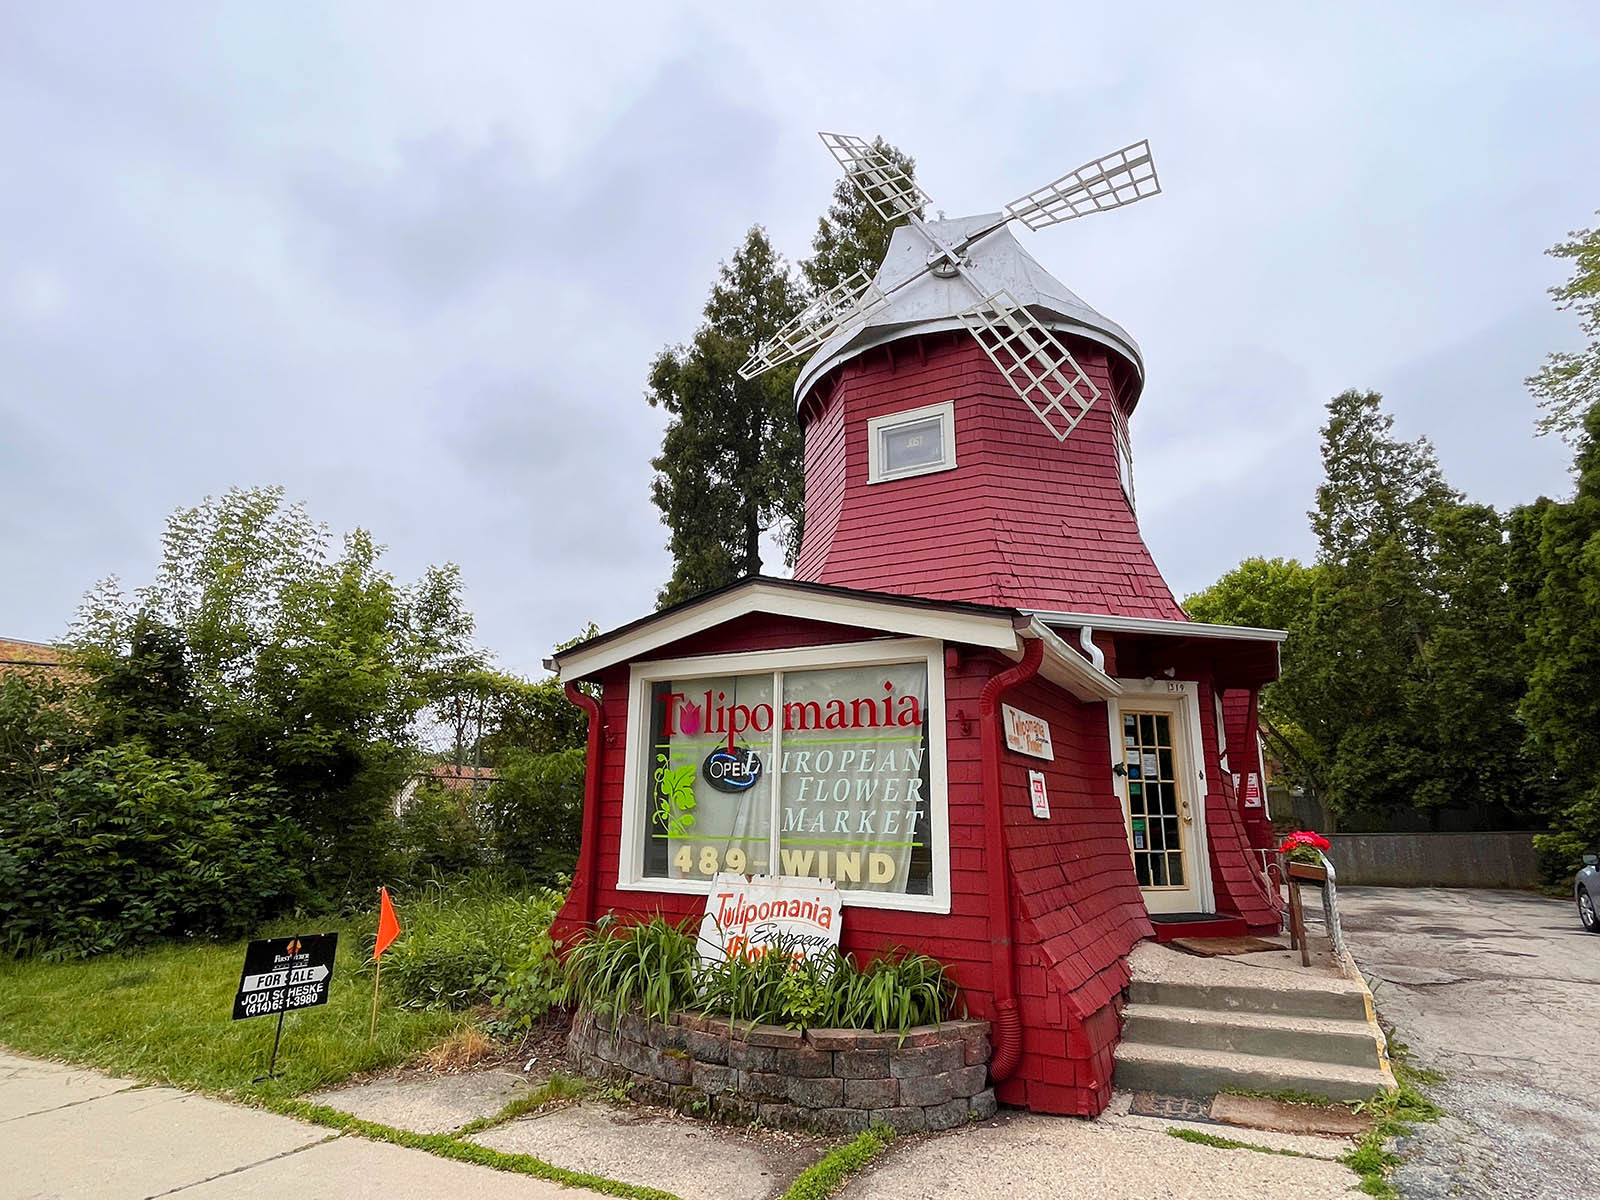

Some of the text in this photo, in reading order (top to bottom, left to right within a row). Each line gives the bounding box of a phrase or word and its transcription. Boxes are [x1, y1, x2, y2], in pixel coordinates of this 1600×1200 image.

[1170, 683, 1185, 692] 319
[745, 747, 925, 776] EUROPEAN
[798, 776, 924, 802] FLOWER
[781, 807, 923, 835] MARKET
[717, 893, 832, 934] Tulipomania
[256, 974, 281, 988] FOR
[241, 991, 270, 1006] JODI
